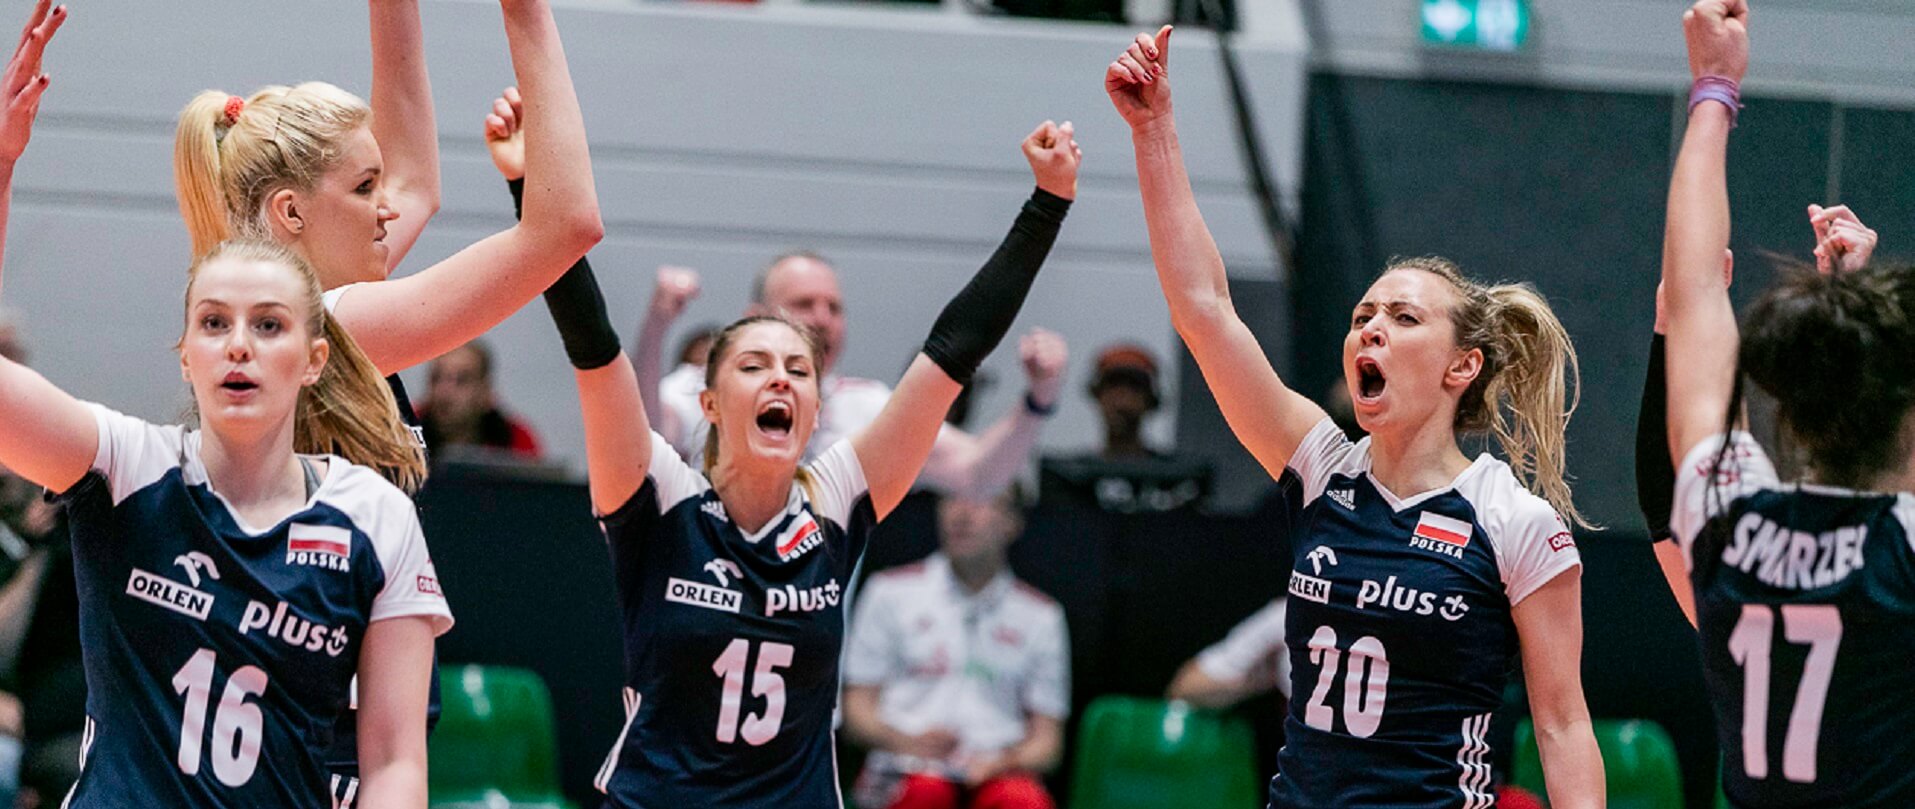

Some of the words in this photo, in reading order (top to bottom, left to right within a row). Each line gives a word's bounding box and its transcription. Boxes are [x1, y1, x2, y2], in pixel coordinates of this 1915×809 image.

[286, 552, 349, 572] POLSKA
[1409, 536, 1463, 559] POLSKA
[133, 576, 207, 614] ORLEN
[671, 583, 736, 608] ORLEN
[1290, 575, 1325, 599] RLEN
[712, 638, 794, 746] 15
[1305, 625, 1390, 738] 20
[1728, 604, 1843, 783] 17
[172, 648, 268, 788] 16
